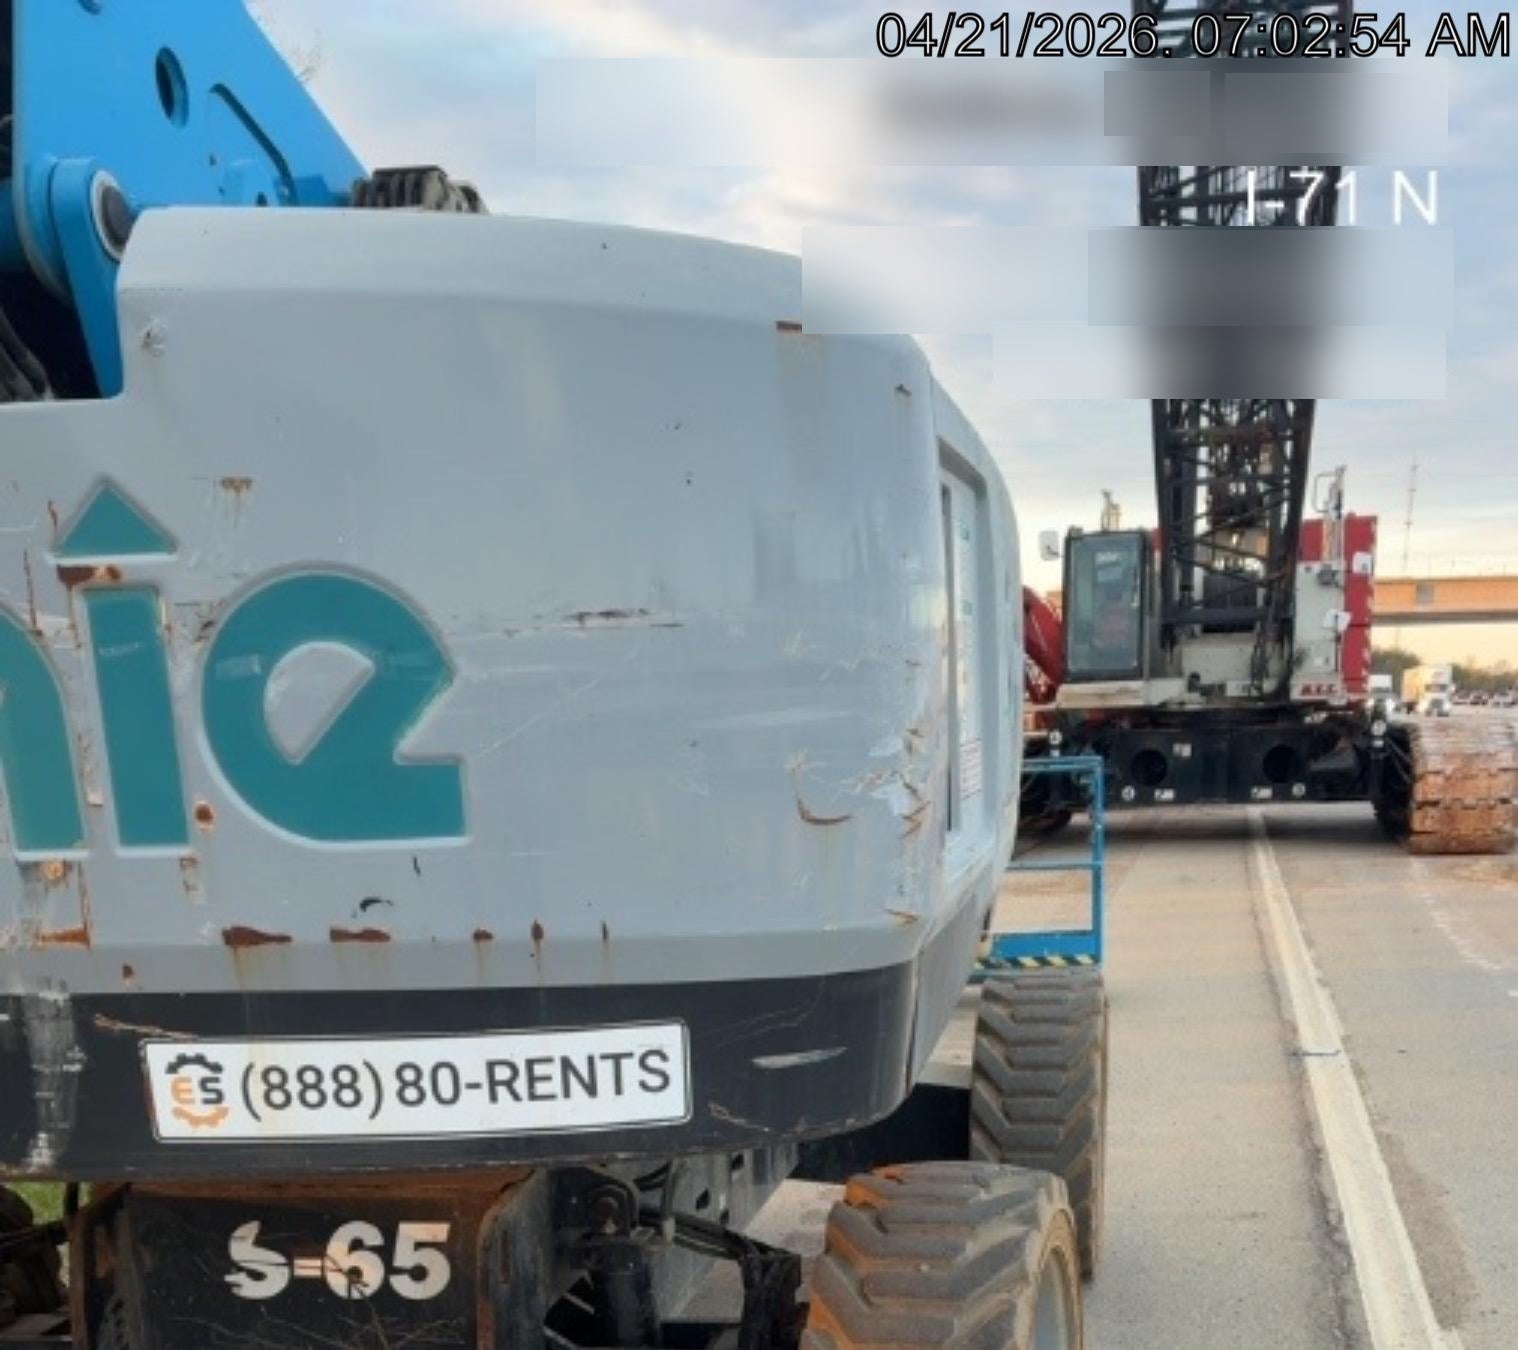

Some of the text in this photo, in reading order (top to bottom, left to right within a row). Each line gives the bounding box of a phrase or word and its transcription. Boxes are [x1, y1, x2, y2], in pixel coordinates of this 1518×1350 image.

[240, 1060, 384, 1121] (888)
[395, 1049, 671, 1106] 80-RENTS
[224, 1220, 451, 1300] S-65
